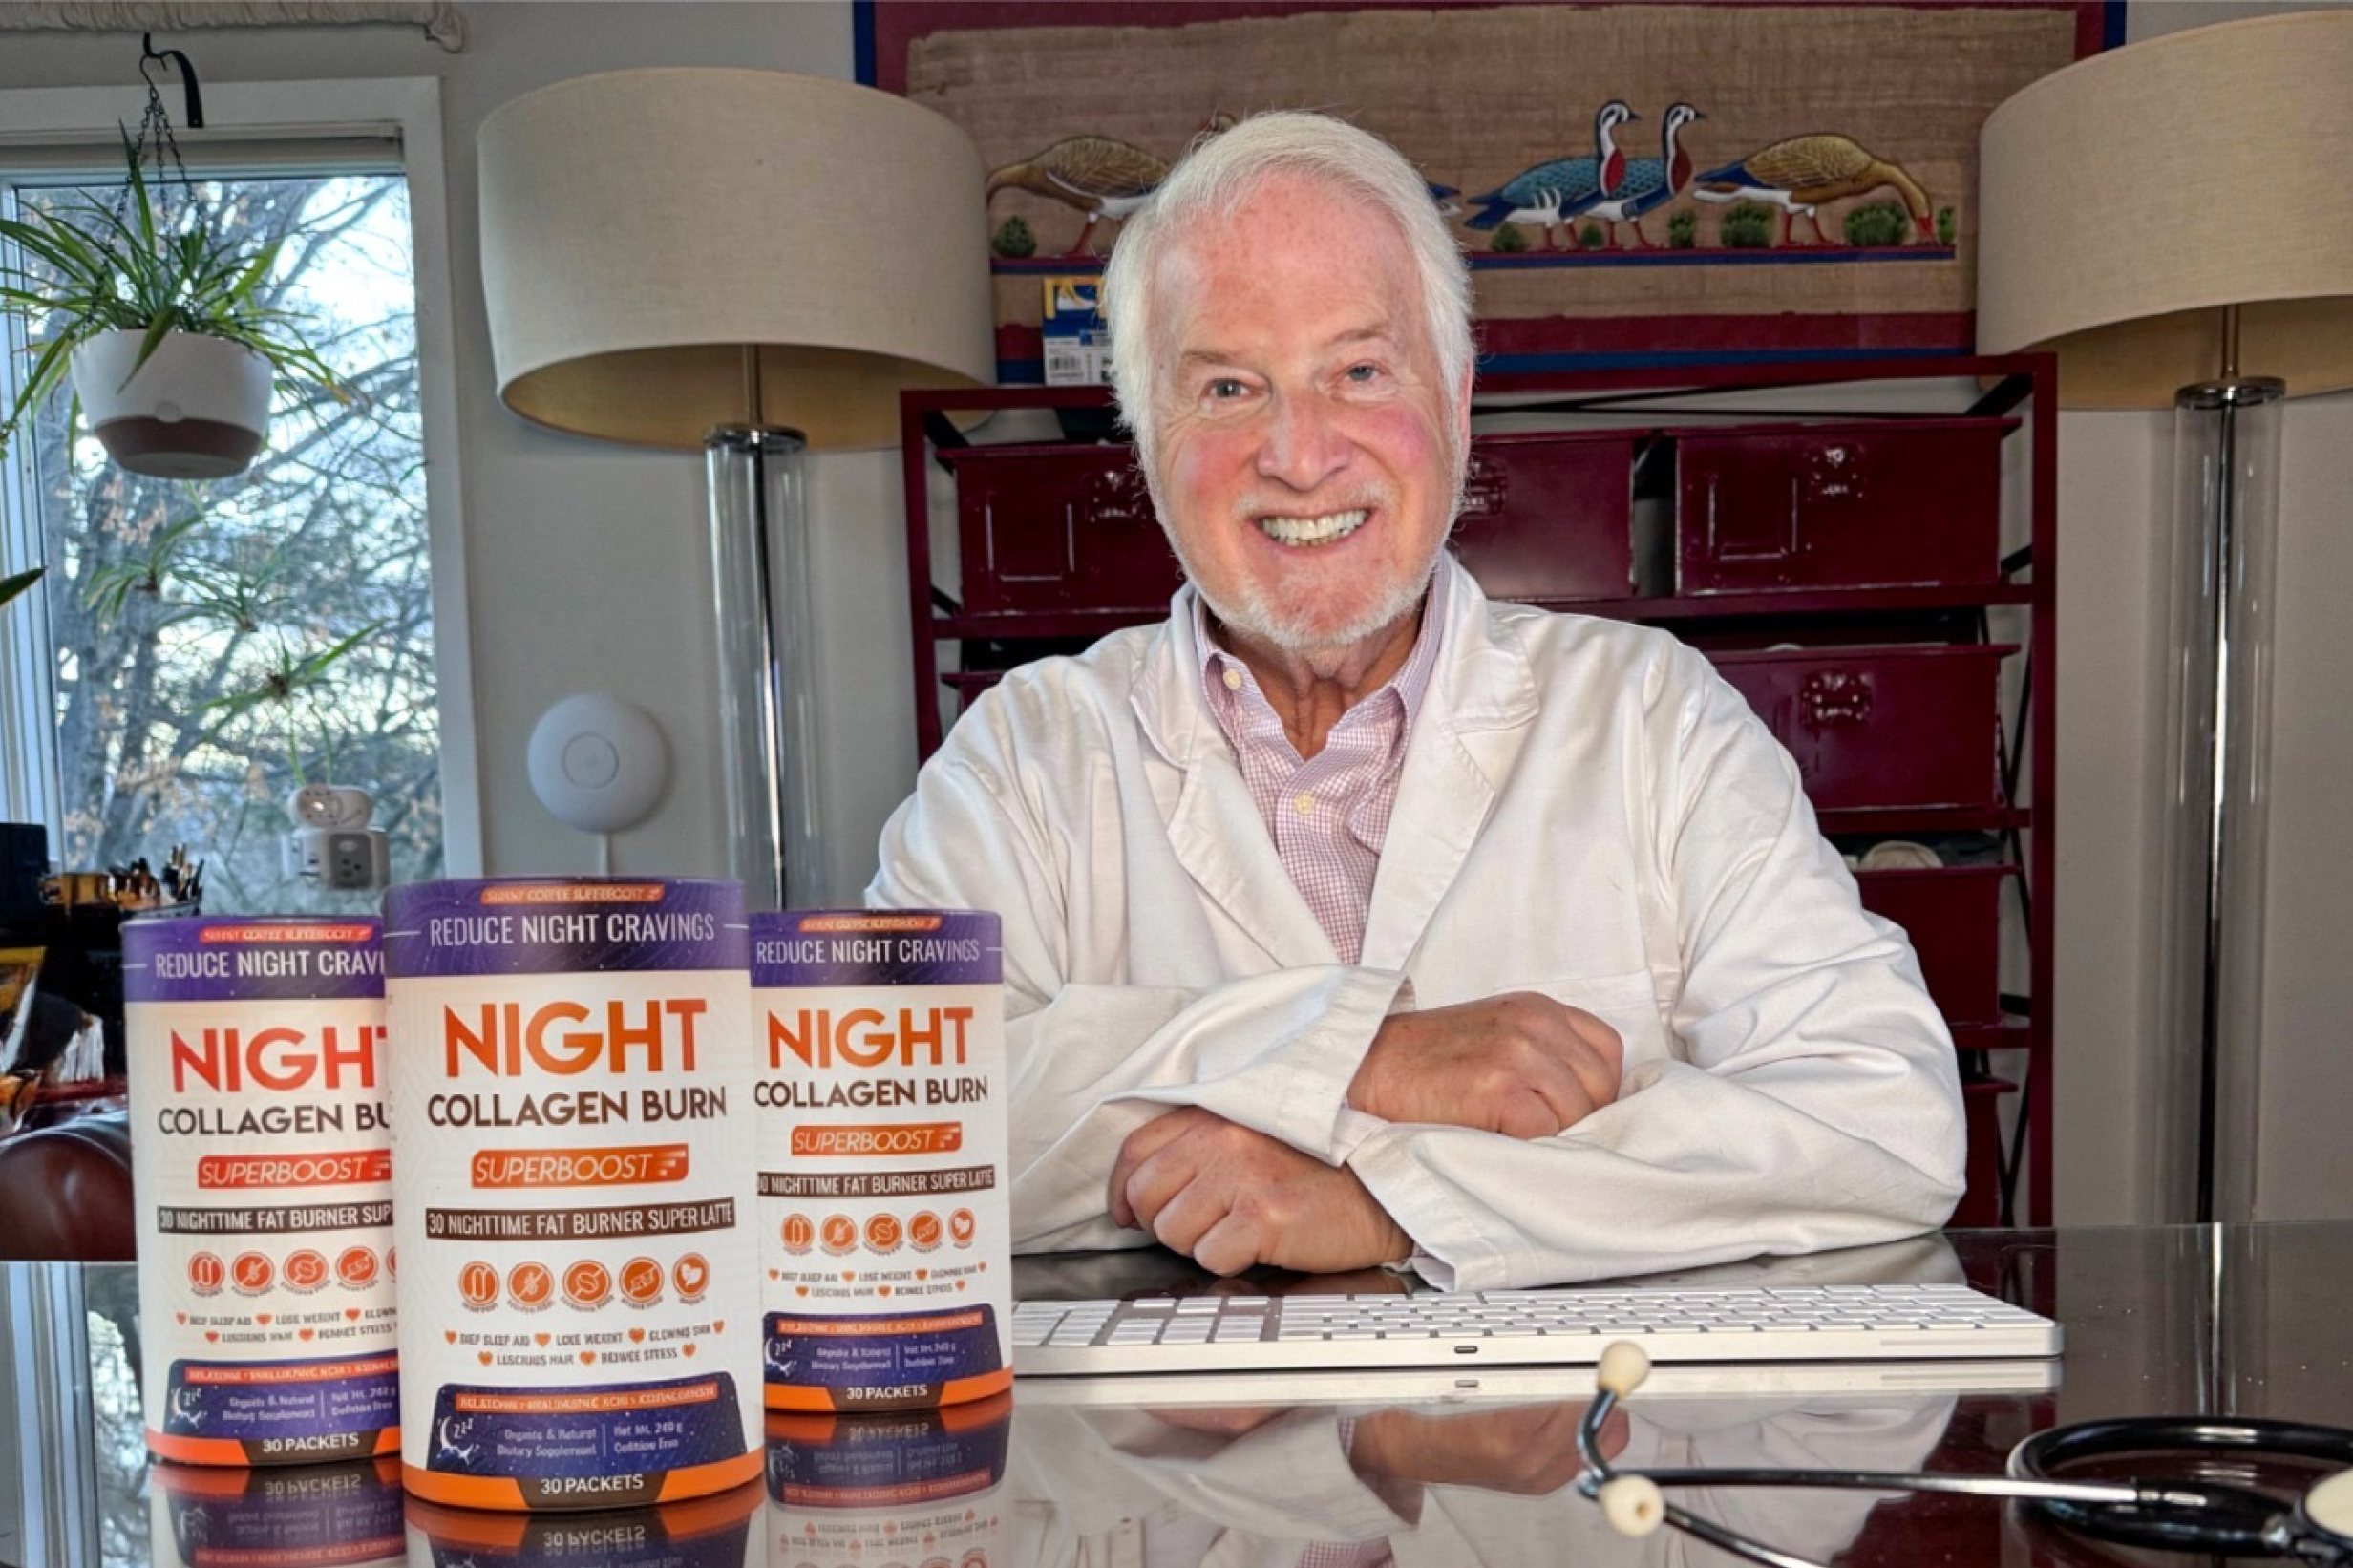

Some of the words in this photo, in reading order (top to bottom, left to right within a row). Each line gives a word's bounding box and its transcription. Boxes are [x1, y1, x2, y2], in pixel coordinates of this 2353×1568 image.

[431, 916, 513, 946] REDUCE
[522, 914, 600, 943] NIGHT
[607, 913, 714, 942] CRAVINGS
[156, 952, 229, 979] REDUCE
[238, 950, 311, 977] NIGHT
[318, 949, 385, 976] CRAVI
[756, 940, 825, 964] REDUCE
[832, 940, 892, 964] NIGHT
[899, 938, 980, 963] CRAVINGS
[444, 999, 707, 1077] NIGHT
[768, 1007, 973, 1069] NIGHT
[171, 1026, 387, 1092] NIGH
[427, 1091, 628, 1127] COLLAGEN
[641, 1086, 726, 1122] BURN
[754, 1079, 915, 1108] COLLAGEN
[925, 1076, 987, 1104] BURN
[159, 1104, 343, 1134] COLLAGEN
[355, 1102, 391, 1129] BU
[794, 1129, 933, 1152] SUPERBOOST
[201, 1157, 367, 1185] SUPERBOOST
[477, 1154, 653, 1183] SUPERBOOST
[771, 1176, 840, 1194] NIGHTTIME
[843, 1176, 868, 1194] FAT
[872, 1175, 927, 1194] BURNER
[930, 1171, 966, 1191] SUPER
[160, 1211, 173, 1228] 30
[176, 1210, 253, 1230] NIGHTTIME
[257, 1210, 286, 1229] FAT
[289, 1207, 358, 1228] BURNER
[362, 1204, 392, 1224] SUP
[429, 1214, 444, 1234] 30
[448, 1214, 531, 1236] NIGHTTIME
[537, 1213, 566, 1235] FAT
[574, 1211, 644, 1234] BURNER
[648, 1207, 697, 1230] SUPER
[701, 1202, 733, 1225] LATTE
[846, 1388, 863, 1400] 30
[865, 1384, 928, 1400] PACKETS
[263, 1438, 280, 1452] 30
[286, 1432, 359, 1451] PACKETS
[541, 1479, 560, 1494] 30
[565, 1474, 644, 1494] PACKETS
